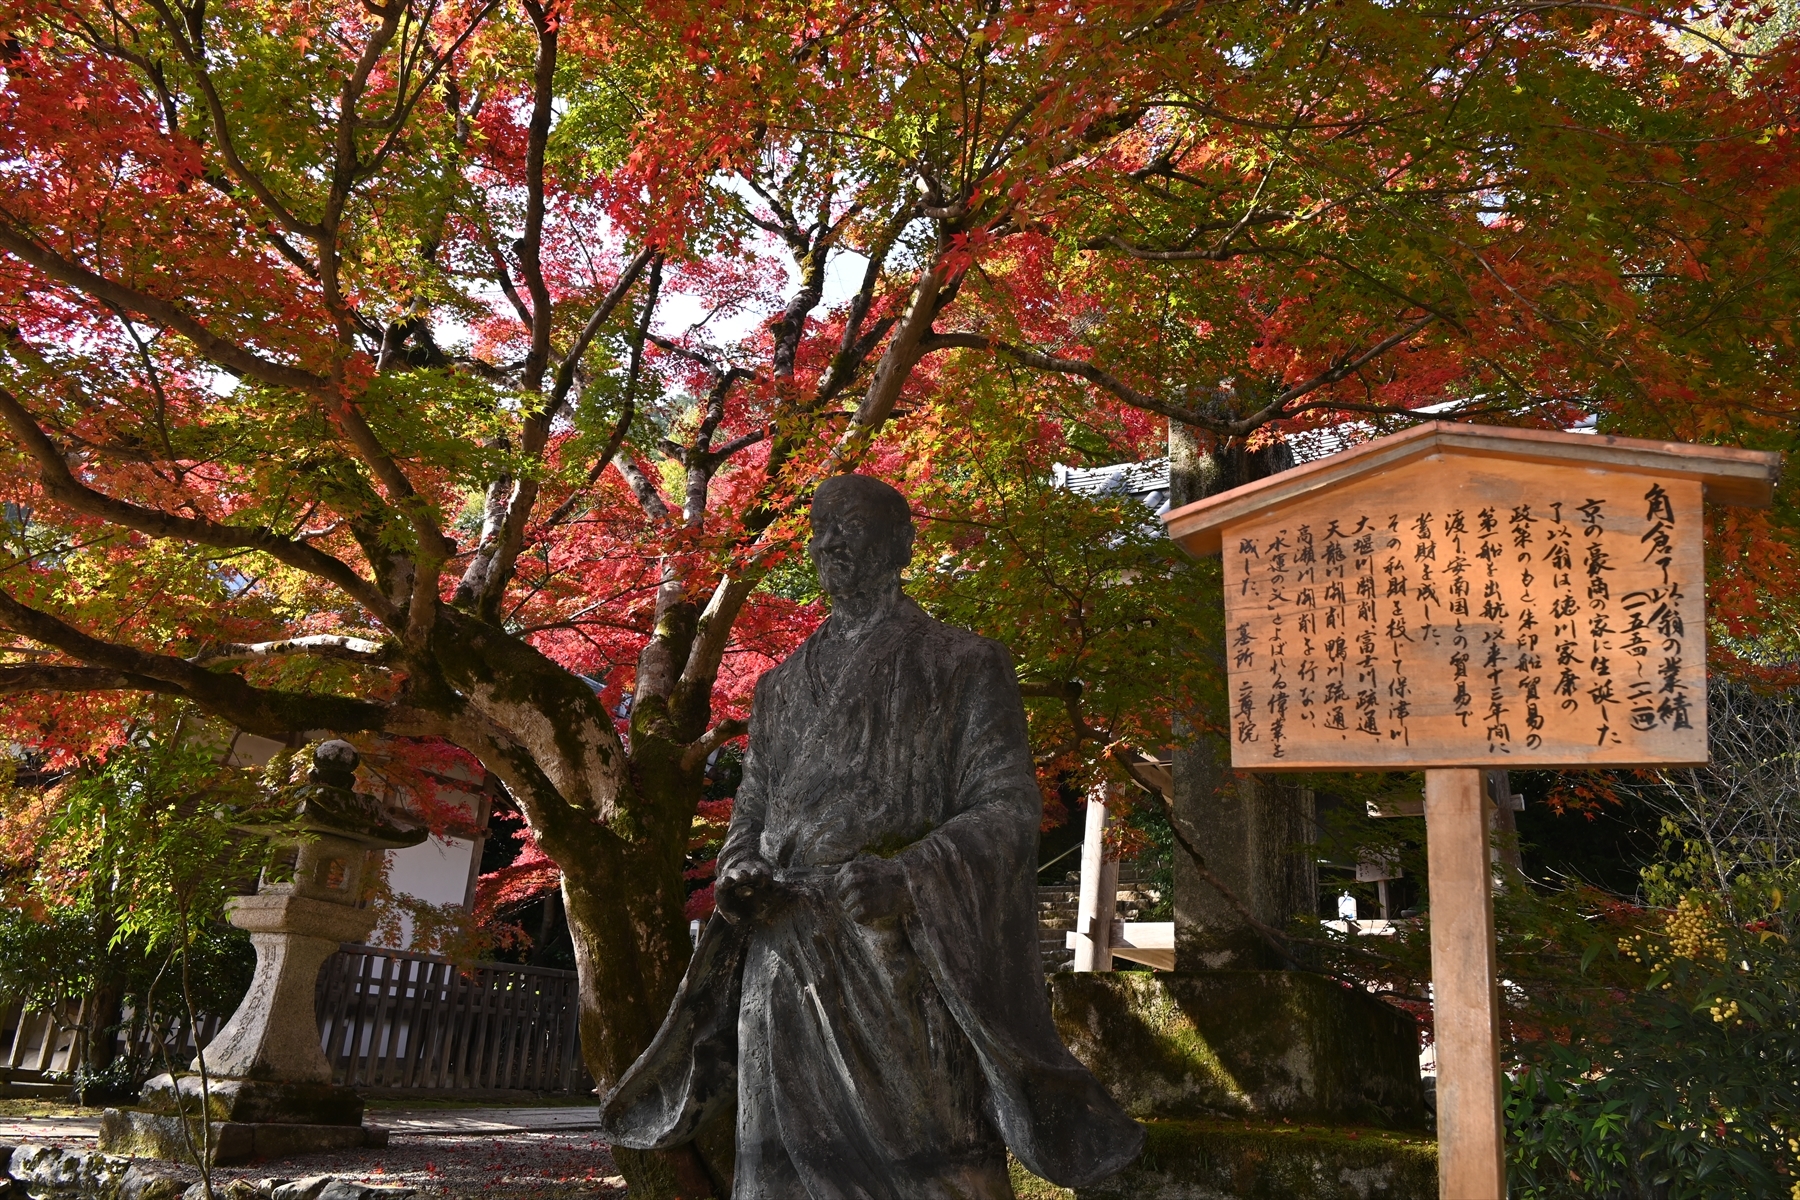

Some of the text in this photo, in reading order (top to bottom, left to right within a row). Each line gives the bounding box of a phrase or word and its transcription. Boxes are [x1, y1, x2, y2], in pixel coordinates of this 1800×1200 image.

[1234, 624, 1256, 668] 墓所
[1236, 680, 1258, 745] 二尊院
[1384, 514, 1414, 746] その私財を投じて保津川
[1442, 510, 1473, 727] 渡り、安南国との貿易で
[1509, 504, 1544, 749] 政策のもと、朱印船貿易の
[1576, 499, 1621, 746] 京の豪商の家に生誕した
[1641, 483, 1693, 731] 角倉了以翁の業績
